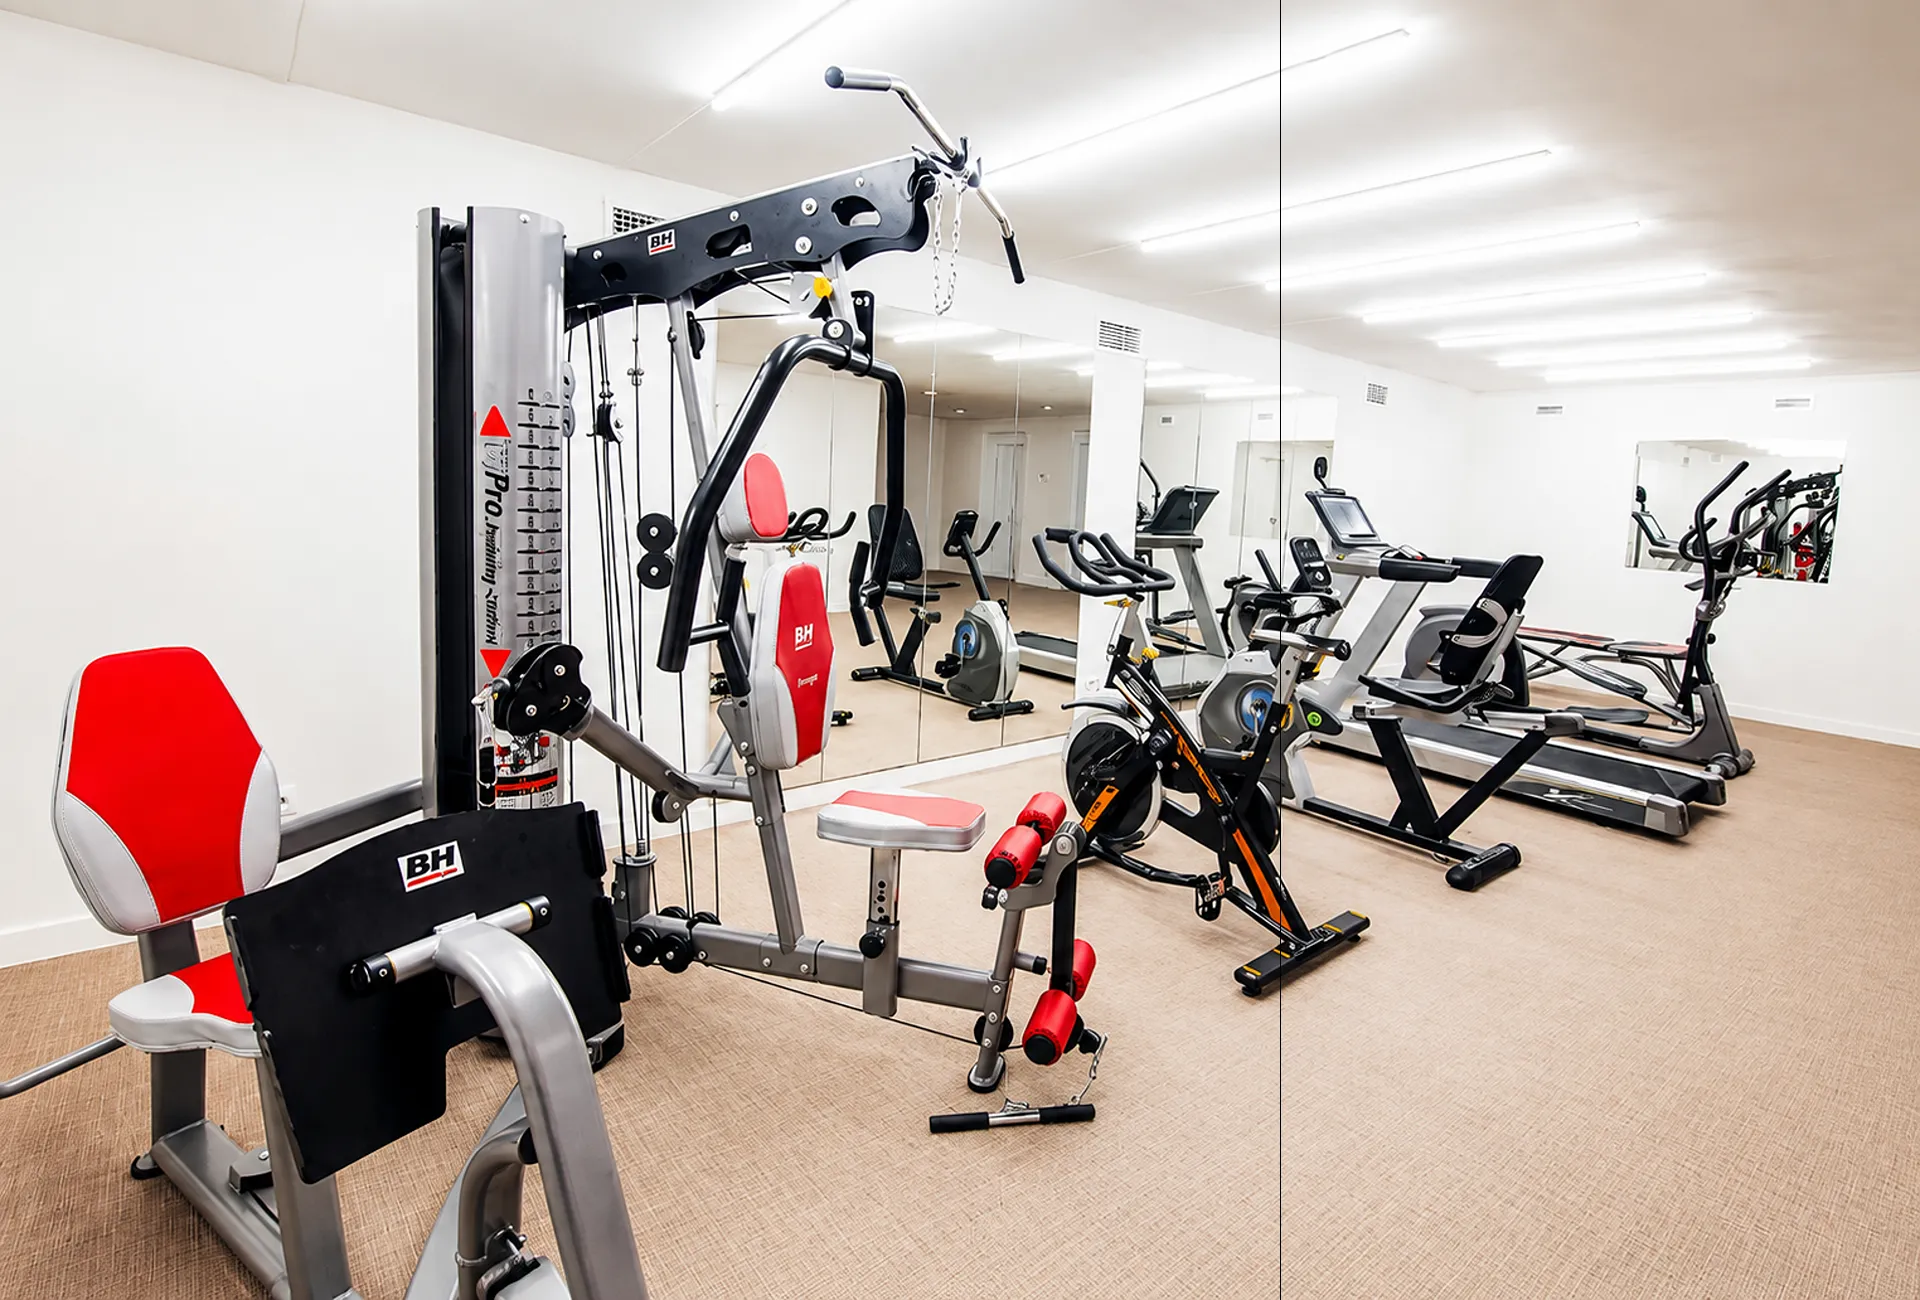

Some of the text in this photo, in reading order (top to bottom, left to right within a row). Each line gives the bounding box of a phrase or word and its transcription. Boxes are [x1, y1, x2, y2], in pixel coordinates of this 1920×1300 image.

[650, 231, 672, 248] BH
[795, 623, 814, 645] BH
[406, 844, 455, 880] BH
